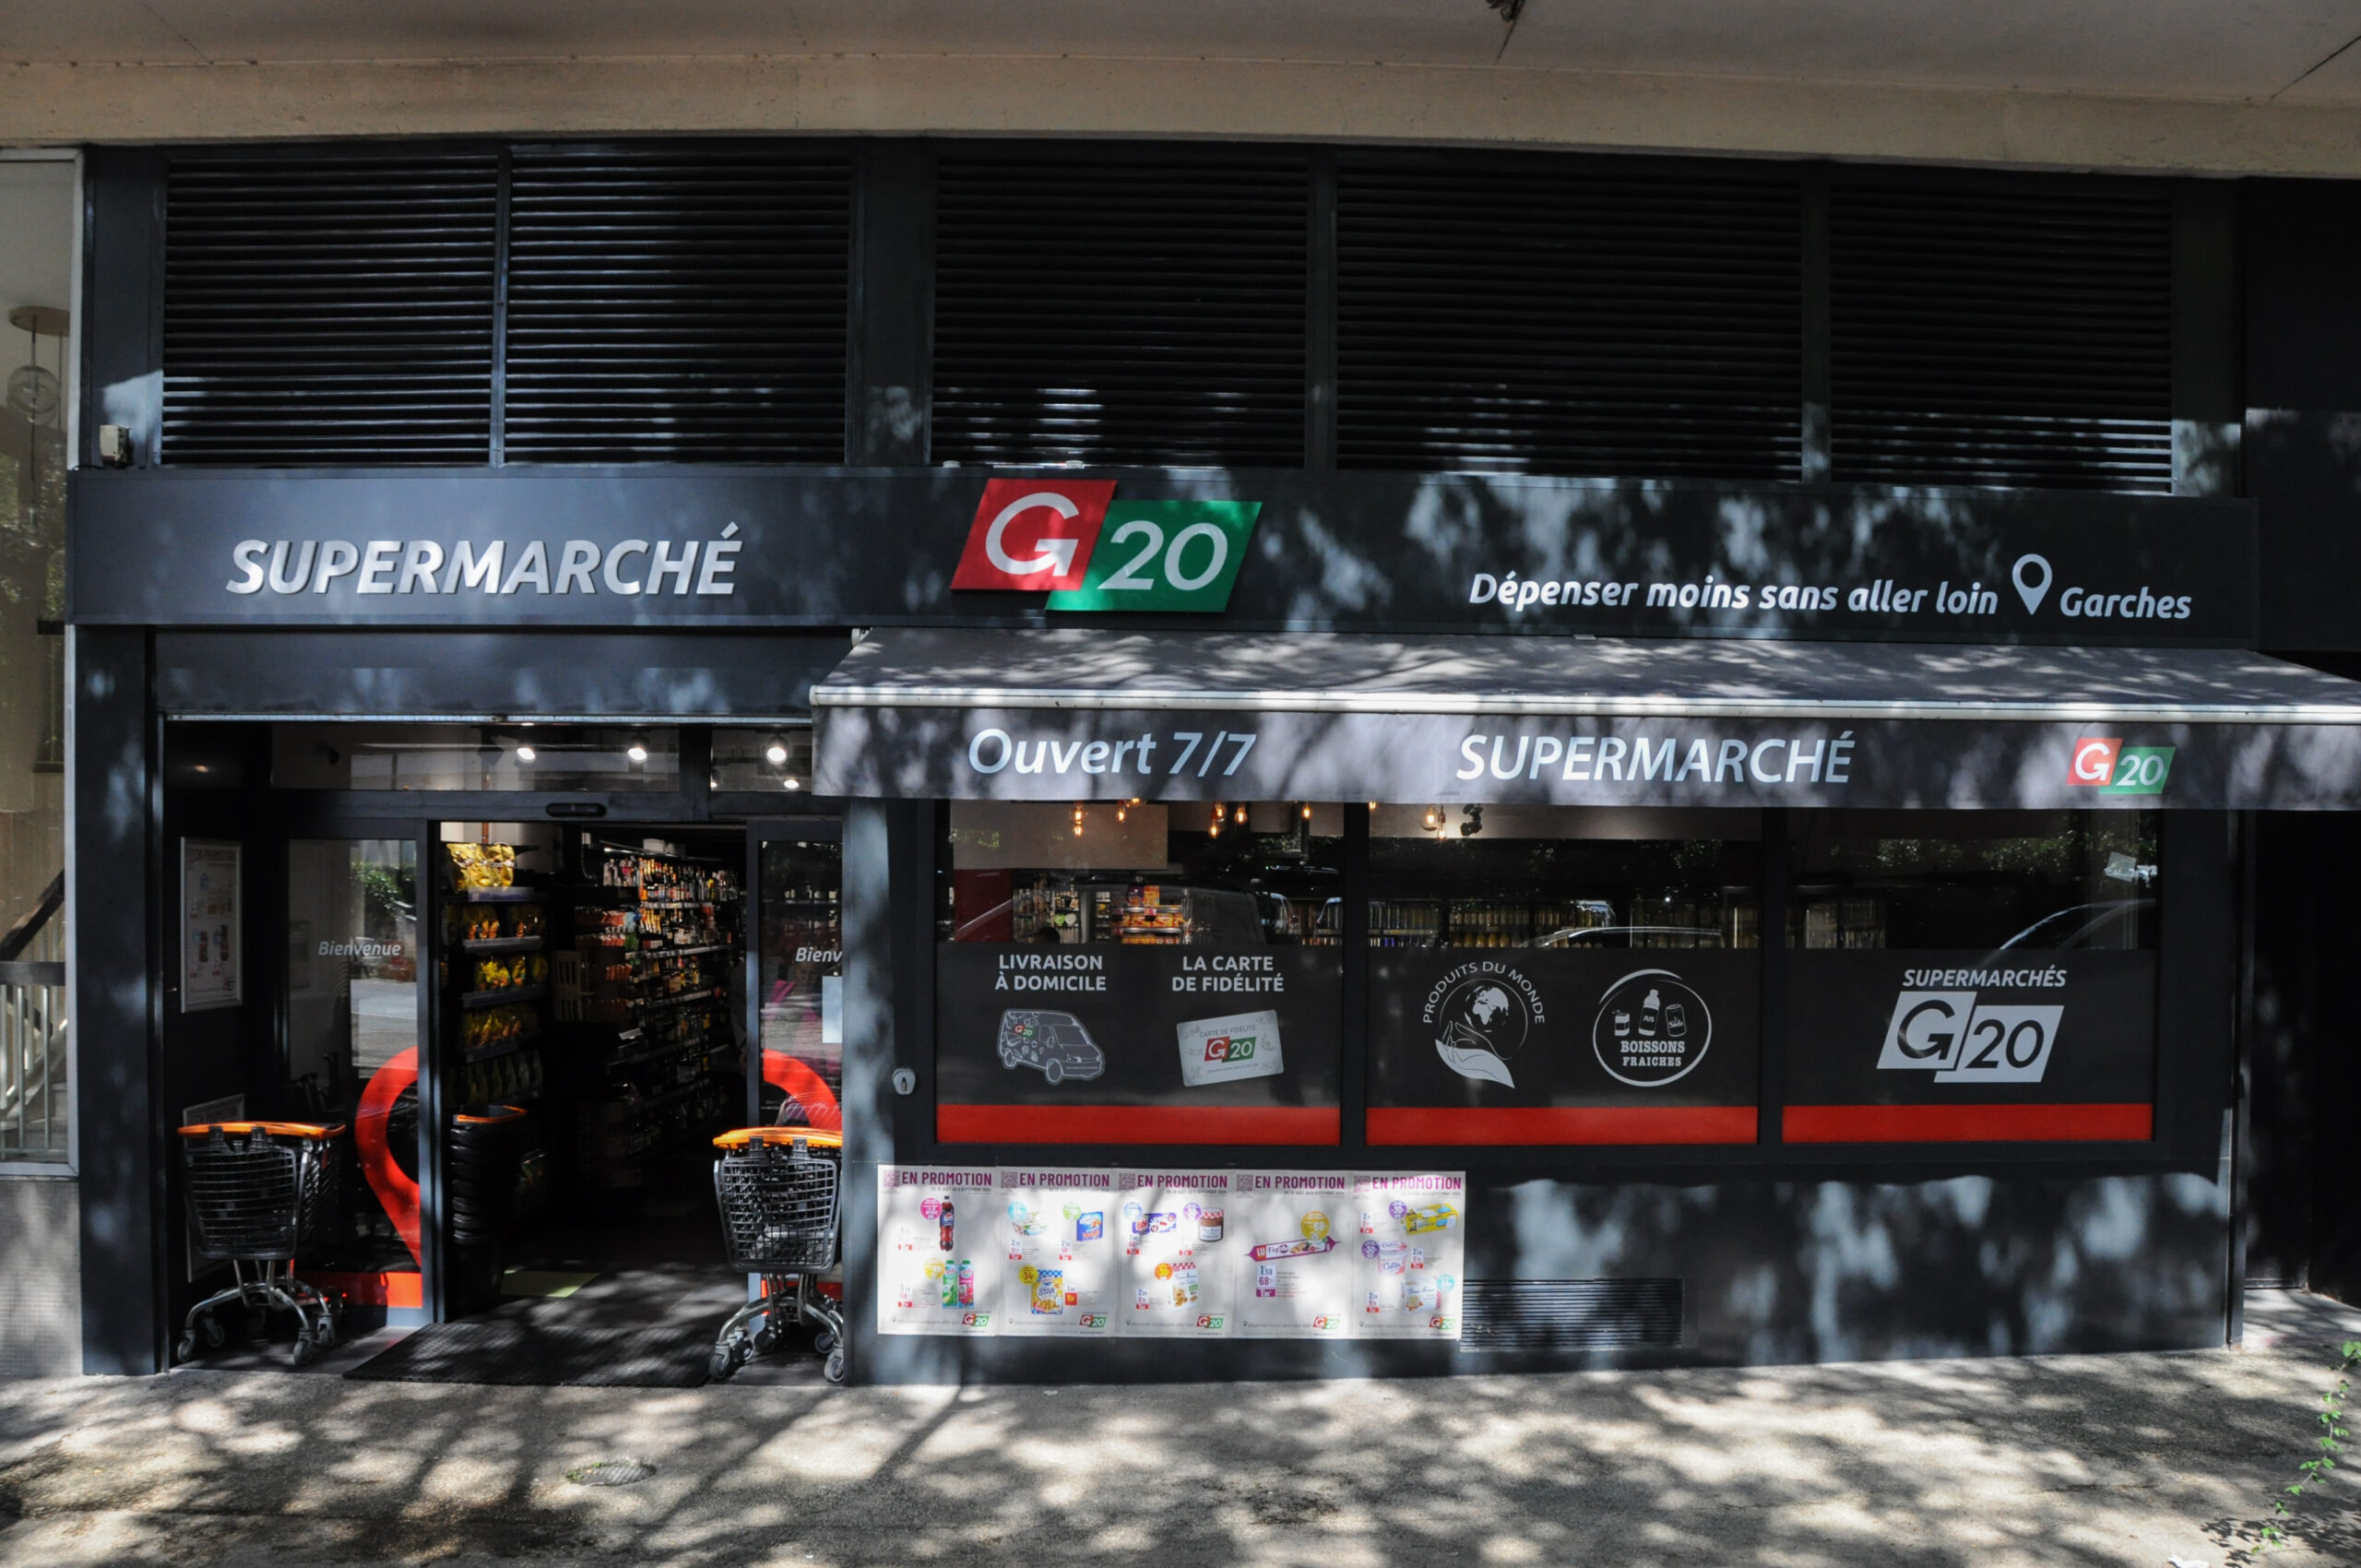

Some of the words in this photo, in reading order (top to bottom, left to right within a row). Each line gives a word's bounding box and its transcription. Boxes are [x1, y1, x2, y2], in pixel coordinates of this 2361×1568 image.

[985, 492, 1228, 591] G20
[225, 521, 743, 597] SUPERMARCHÉ
[1468, 569, 1639, 612] Dépenser
[1645, 575, 1750, 610] moins
[1758, 584, 1839, 611] sans
[1847, 579, 1928, 613] aller
[1935, 581, 1999, 615] loin
[2059, 586, 2192, 620] Garches
[967, 727, 1157, 776] Ouvert
[1166, 730, 1257, 778] 7/7
[1454, 731, 1857, 784] SUPERMARCHÉ
[2074, 742, 2165, 787] G20
[318, 940, 402, 956] Bienvenue
[794, 945, 843, 963] Bienv
[999, 954, 1103, 970] LIVRAISON
[1182, 956, 1207, 971] LA
[1212, 956, 1275, 971] CARTE
[994, 970, 1009, 991] À
[1014, 975, 1107, 992] DOMICILE
[1172, 977, 1197, 992] DE
[1202, 972, 1285, 992] FIDÉLITÉ
[1902, 964, 2068, 988] SUPERMARCHÉS
[1422, 961, 1478, 1024] PRODUITS
[1482, 961, 1506, 974] DU
[1508, 969, 1546, 1024] MONDE
[1643, 1015, 1655, 1023] JUS
[1200, 1029, 1218, 1038] CARTE
[1896, 999, 2045, 1069] G20
[1208, 1039, 1253, 1059] G20
[1620, 1040, 1685, 1053] BOISSONS
[1622, 1056, 1682, 1067] FRAICHES
[902, 1171, 918, 1184] EN
[921, 1171, 992, 1186] PROMOTION
[1019, 1172, 1036, 1186] EN
[1039, 1173, 1109, 1187] PROMOTION
[1137, 1174, 1154, 1188] EN
[1157, 1175, 1228, 1189] PROMOTION
[1255, 1175, 1271, 1189] EN
[1275, 1176, 1345, 1190] PROMOTION
[1372, 1176, 1388, 1190] EN
[1393, 1177, 1462, 1191] PROMOTION
[1257, 1247, 1265, 1257] LU
[964, 1313, 988, 1326] G20
[1081, 1314, 1105, 1327] G20
[1198, 1315, 1222, 1328] G20
[1314, 1316, 1338, 1329] G20
[1430, 1316, 1454, 1329] G20
